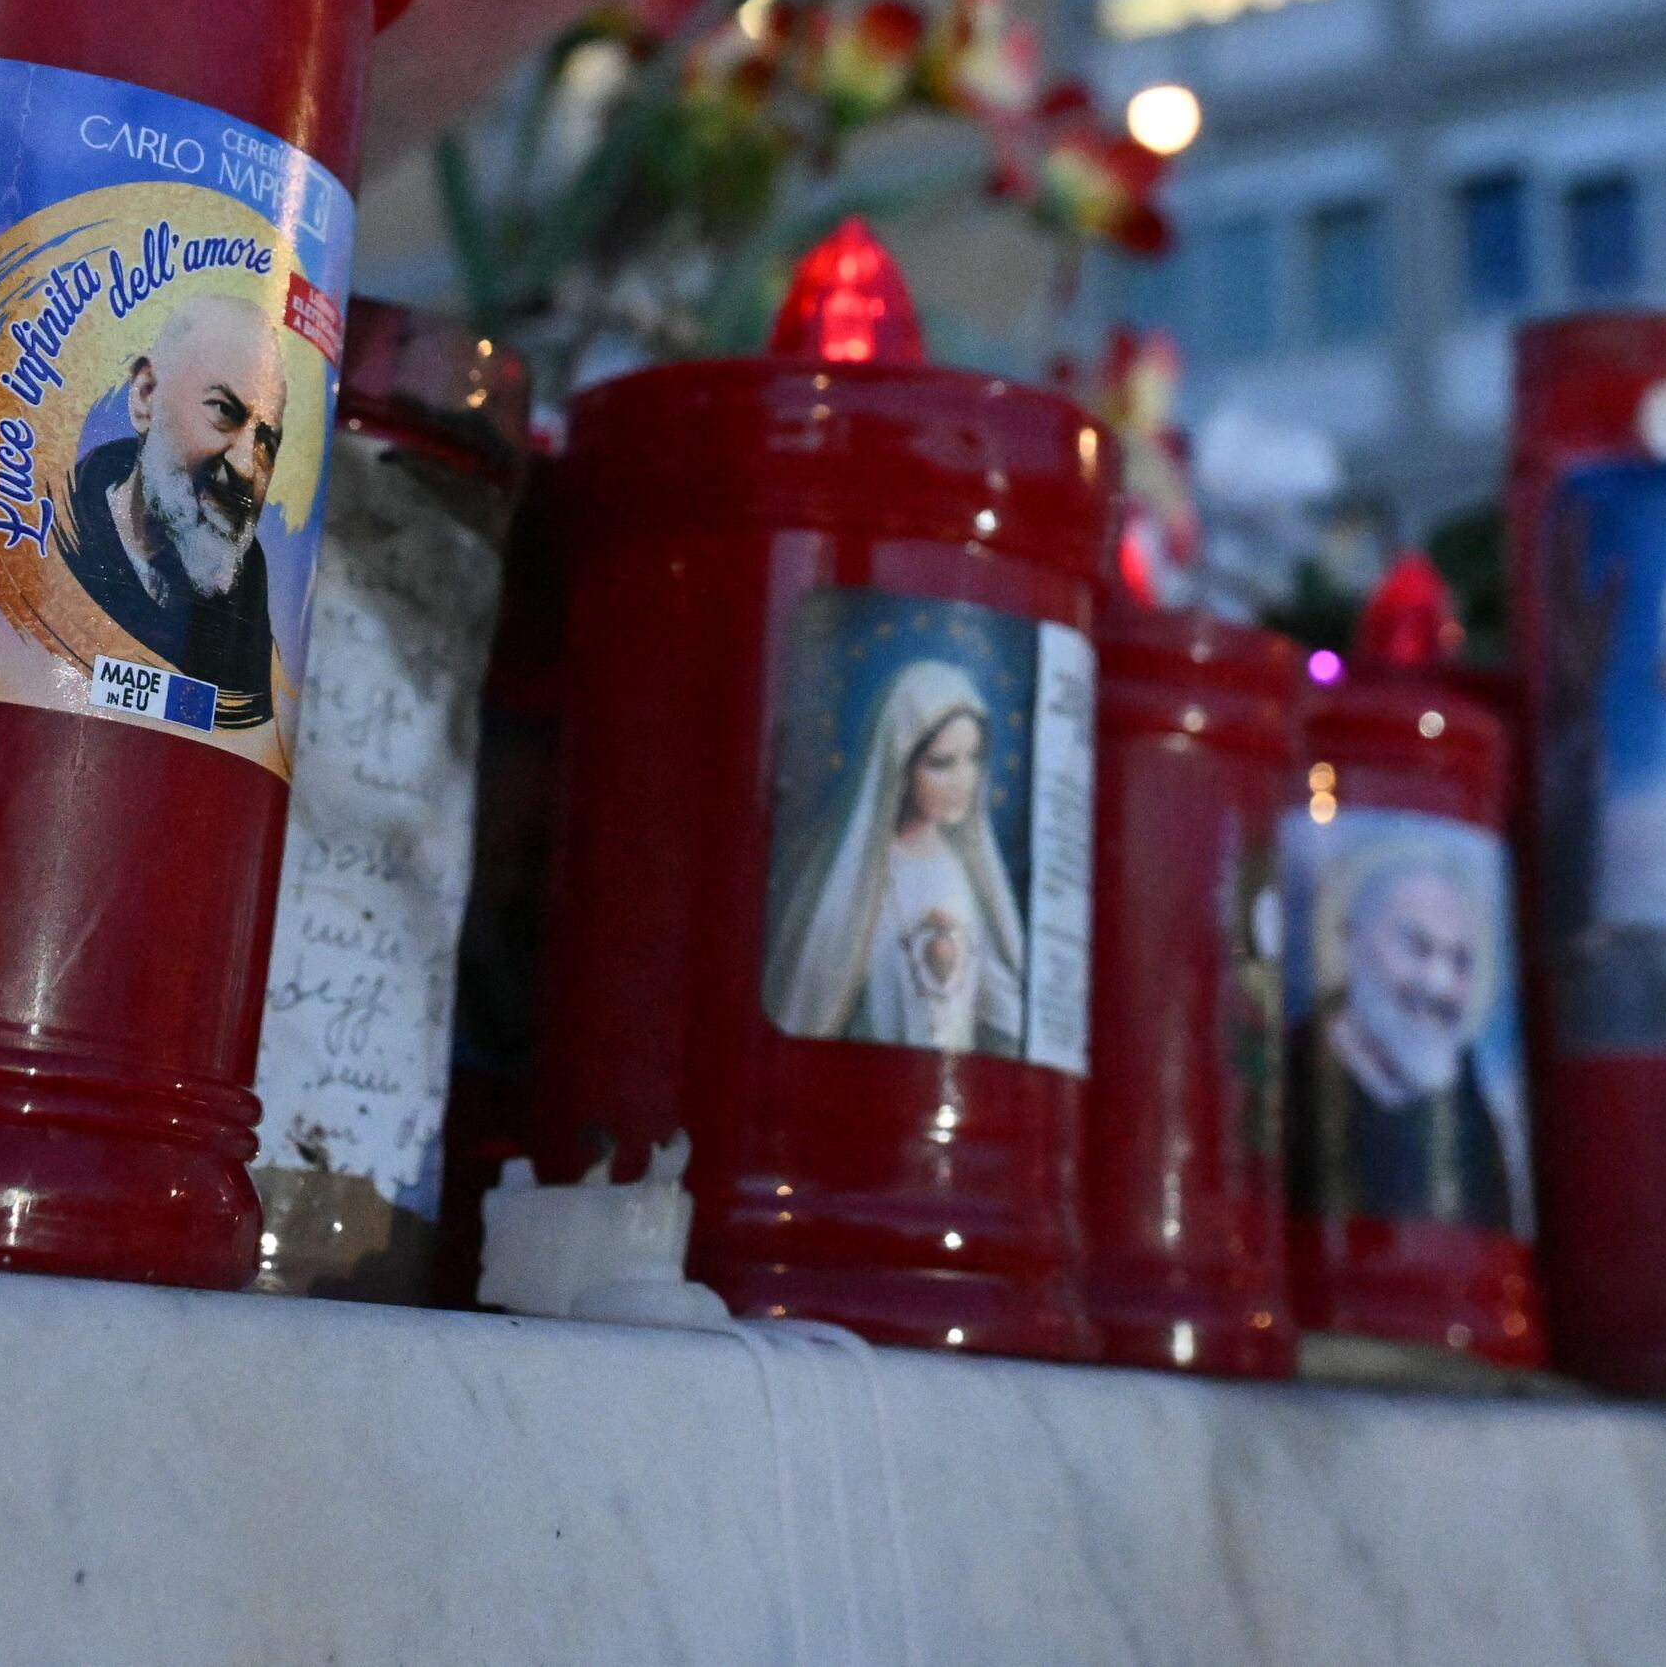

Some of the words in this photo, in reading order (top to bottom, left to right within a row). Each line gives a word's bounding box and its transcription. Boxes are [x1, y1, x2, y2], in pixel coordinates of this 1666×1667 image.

[80, 115, 205, 174] CARLO
[219, 153, 290, 211] NAPP
[0, 260, 101, 407] infinita
[100, 661, 162, 694] MADE
[106, 691, 120, 706] IN
[122, 687, 150, 712] EU
